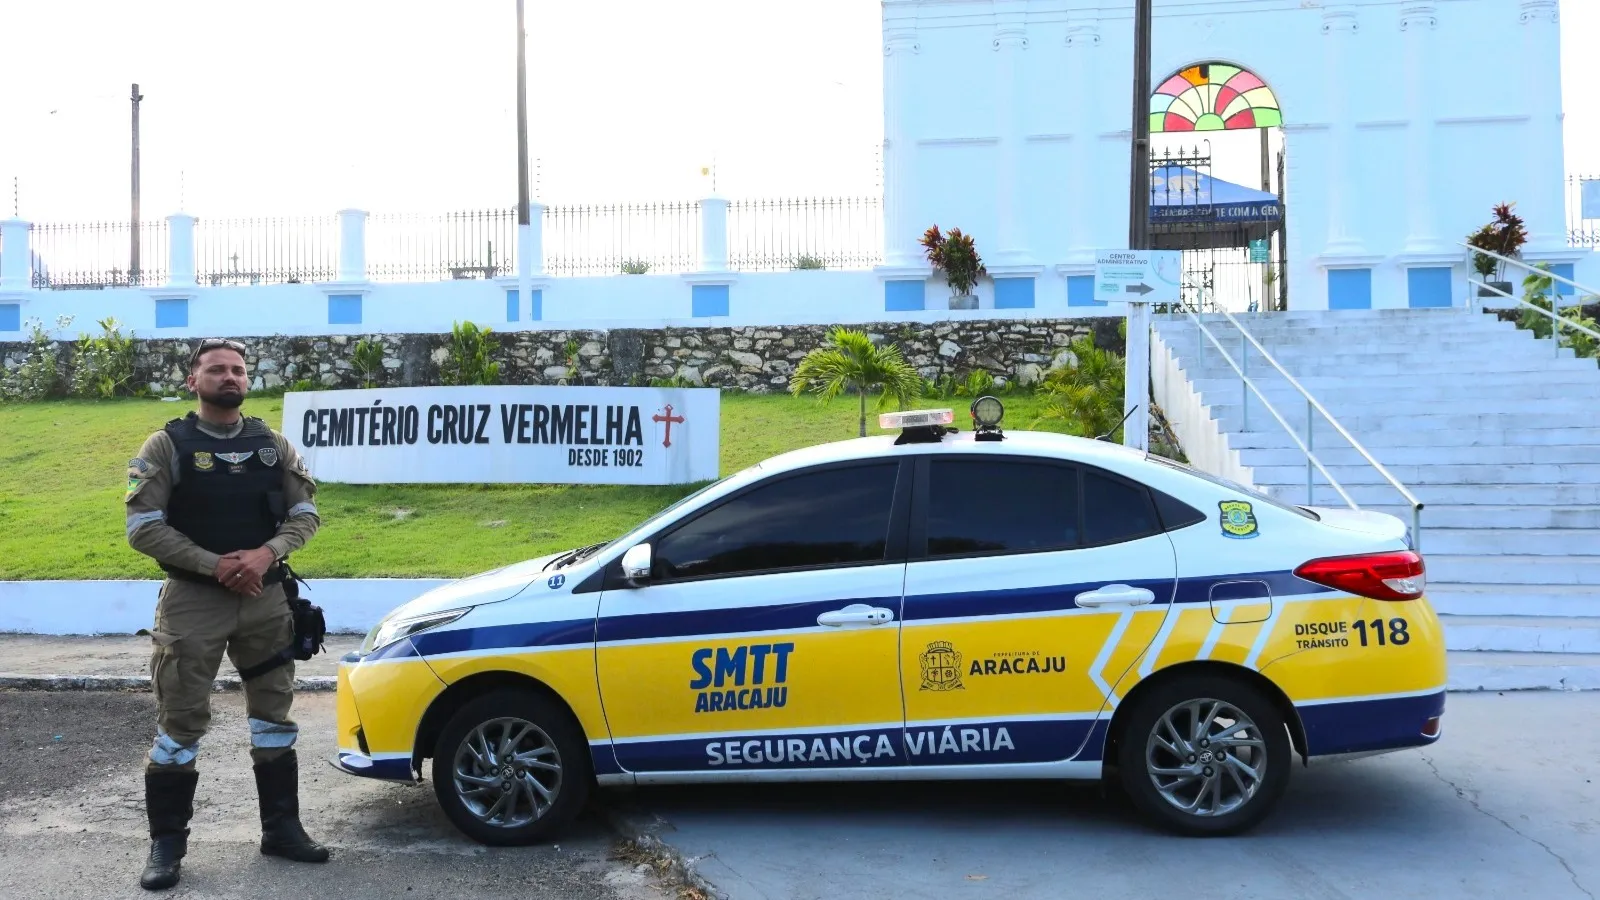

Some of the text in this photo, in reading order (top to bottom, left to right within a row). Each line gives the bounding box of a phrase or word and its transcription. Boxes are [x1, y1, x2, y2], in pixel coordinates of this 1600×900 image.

[302, 399, 643, 447] CEMITÉRIO CRUZ VERMELHA
[568, 448, 643, 467] DESDE 1902
[549, 576, 563, 587] 11
[1294, 621, 1347, 636] DISQUE
[1352, 617, 1410, 647] 118
[1296, 636, 1349, 649] TRÂNSITO
[690, 642, 795, 690] SMTT
[969, 656, 1066, 676] ARACAJU
[694, 687, 788, 713] ARACAJU
[705, 726, 1015, 766] SEGURANÇA VIÁRIA
